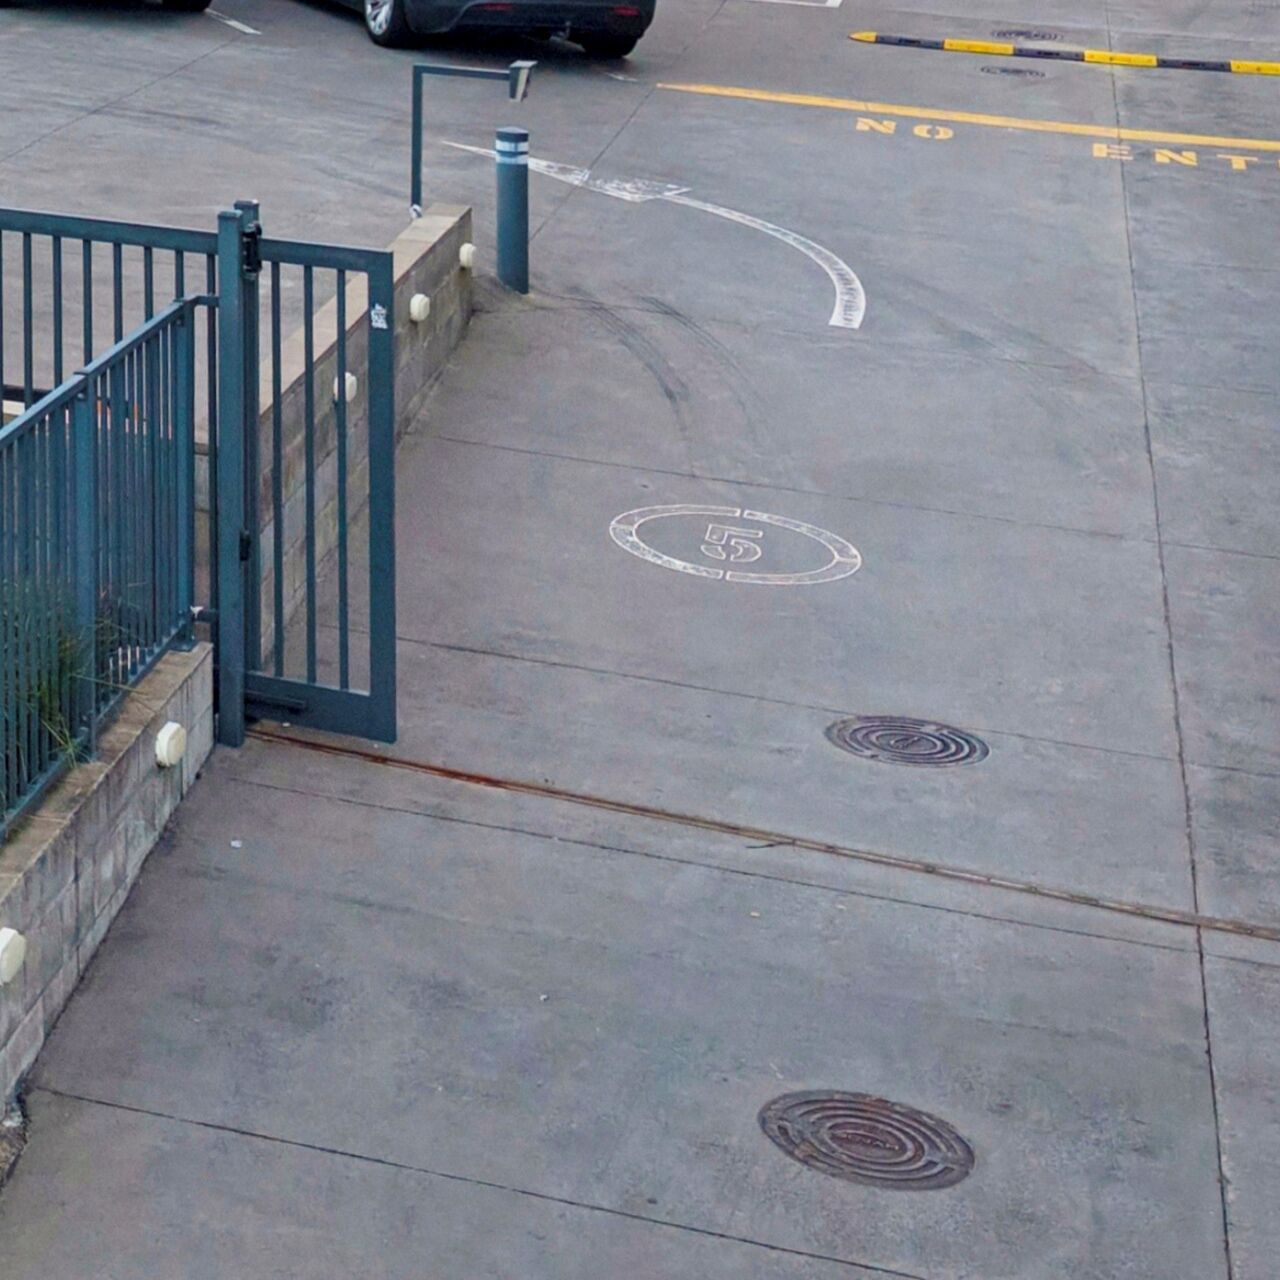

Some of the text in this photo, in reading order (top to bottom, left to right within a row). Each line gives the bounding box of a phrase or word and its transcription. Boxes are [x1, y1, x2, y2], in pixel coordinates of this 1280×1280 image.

[855, 117, 1280, 170] NO ENT
[700, 523, 764, 562] 5
